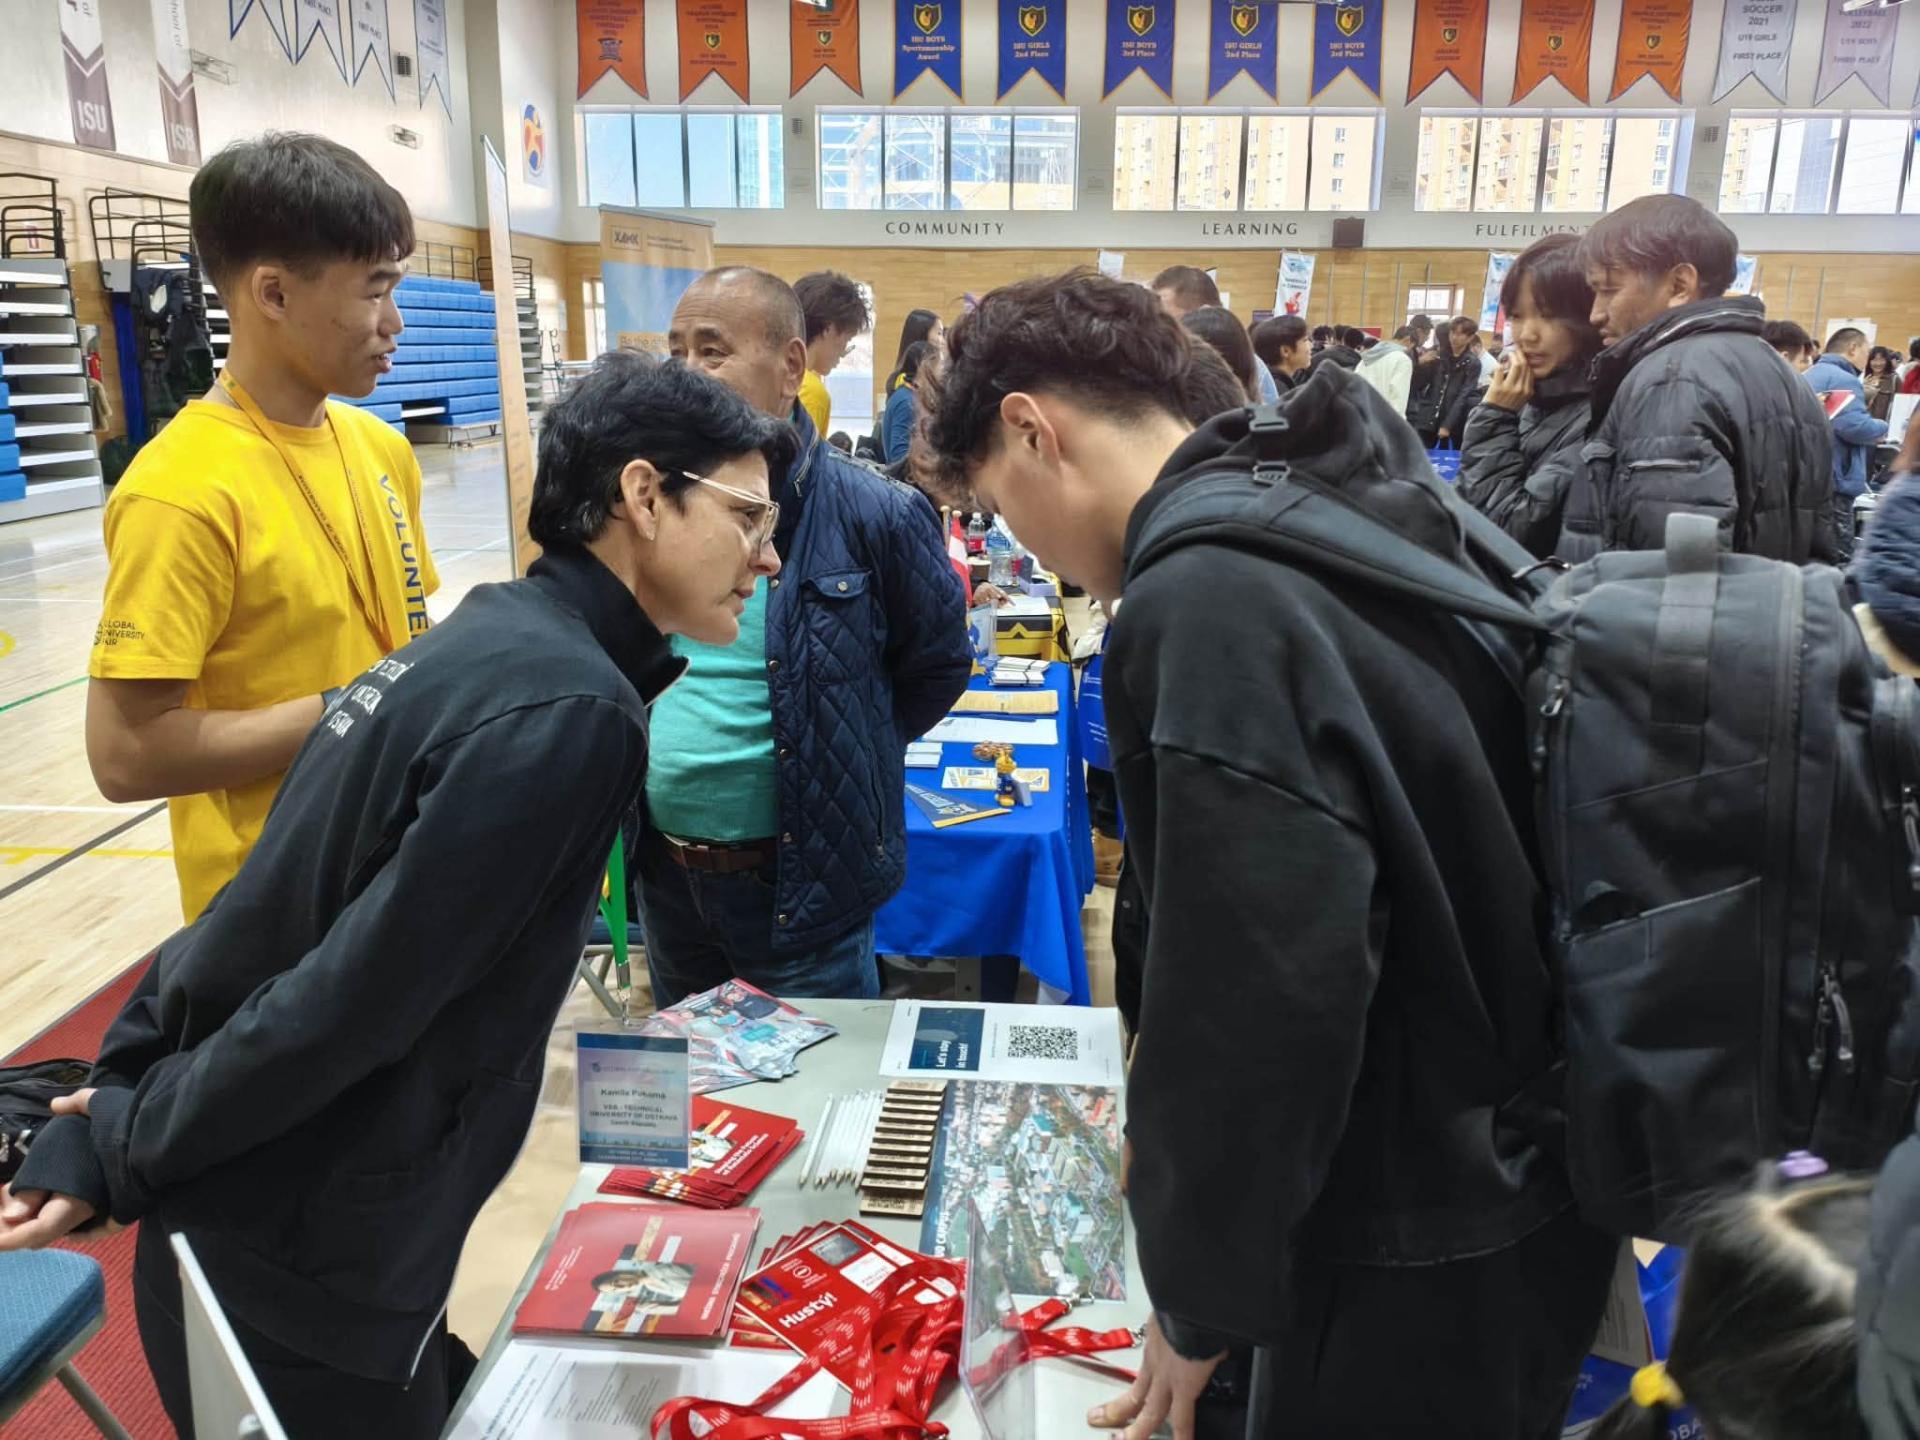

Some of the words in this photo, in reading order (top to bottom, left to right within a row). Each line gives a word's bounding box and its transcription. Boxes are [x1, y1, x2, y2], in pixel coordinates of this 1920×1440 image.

[1742, 4, 1783, 14] SOCCER
[1748, 16, 1769, 26] 2021
[1733, 52, 1754, 60] FIRST
[1756, 52, 1782, 60] PLACE
[77, 100, 107, 133] ISU
[885, 222, 1005, 235] COMMUNITY
[1202, 222, 1299, 235] LEARNING
[1476, 224, 1592, 236] FULFILMEN
[105, 619, 135, 630] LOBAL
[104, 629, 145, 639] NIVERSITY
[624, 1104, 664, 1112] TECHNICAL
[589, 1110, 632, 1118] UNIVERSITY
[779, 1292, 837, 1328] Hustý!
